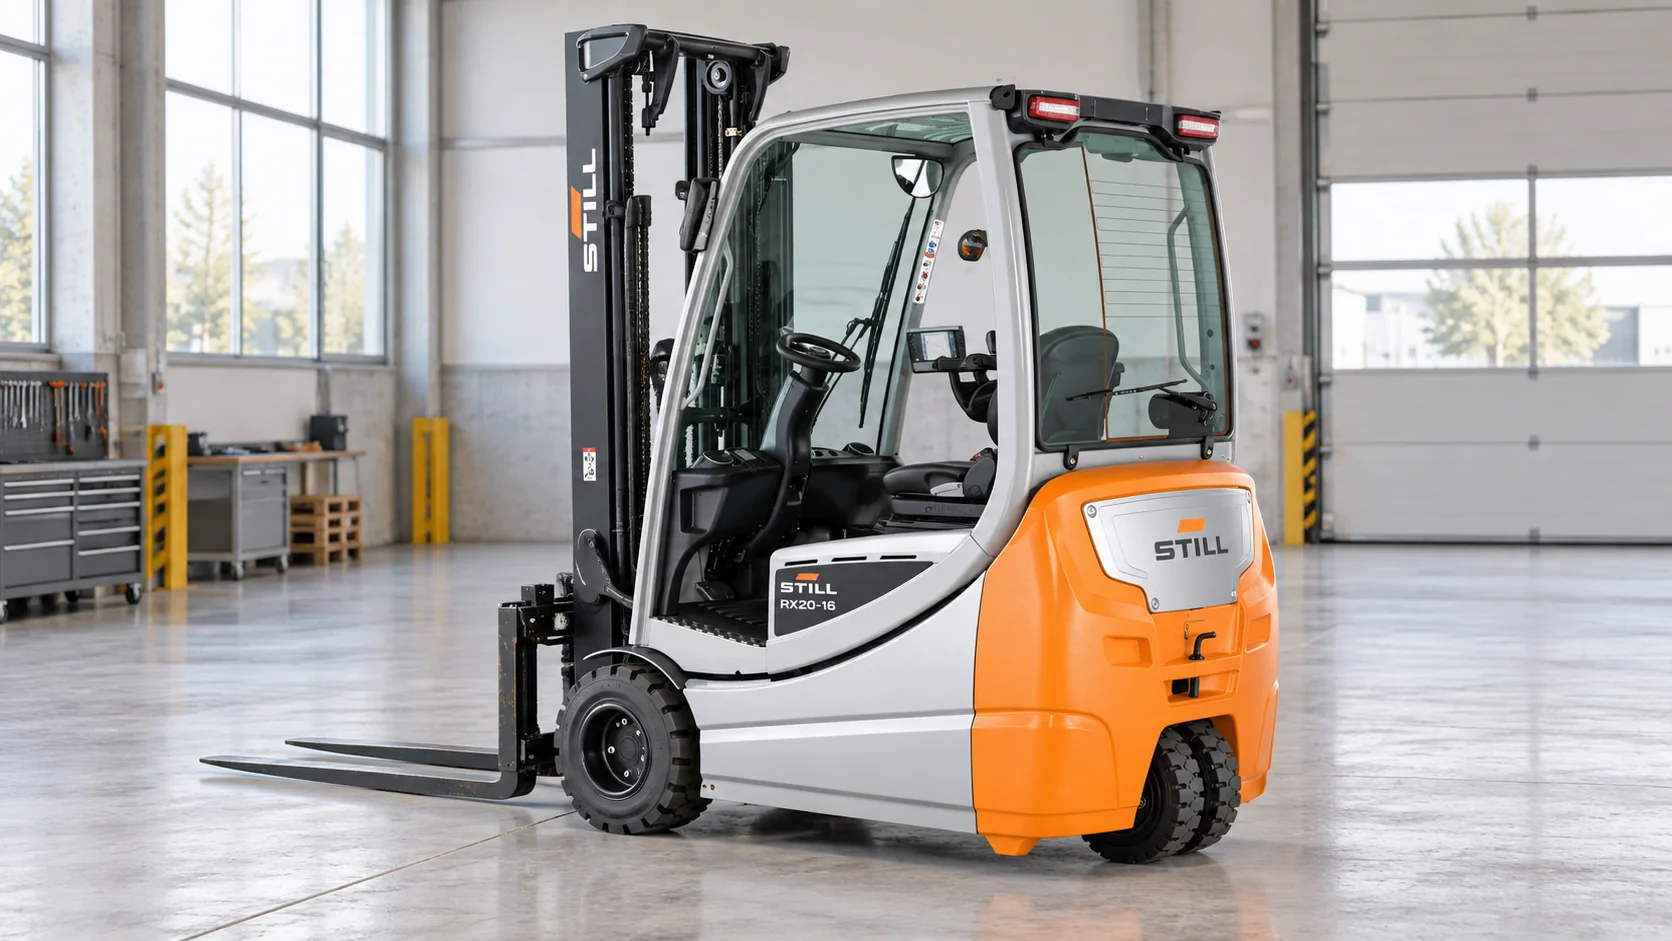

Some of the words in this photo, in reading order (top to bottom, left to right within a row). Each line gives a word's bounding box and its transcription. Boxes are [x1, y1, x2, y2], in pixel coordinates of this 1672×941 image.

[582, 148, 597, 272] STILL
[1154, 535, 1229, 561] STILL
[780, 582, 838, 595] STILL
[780, 599, 836, 611] RX20-16
